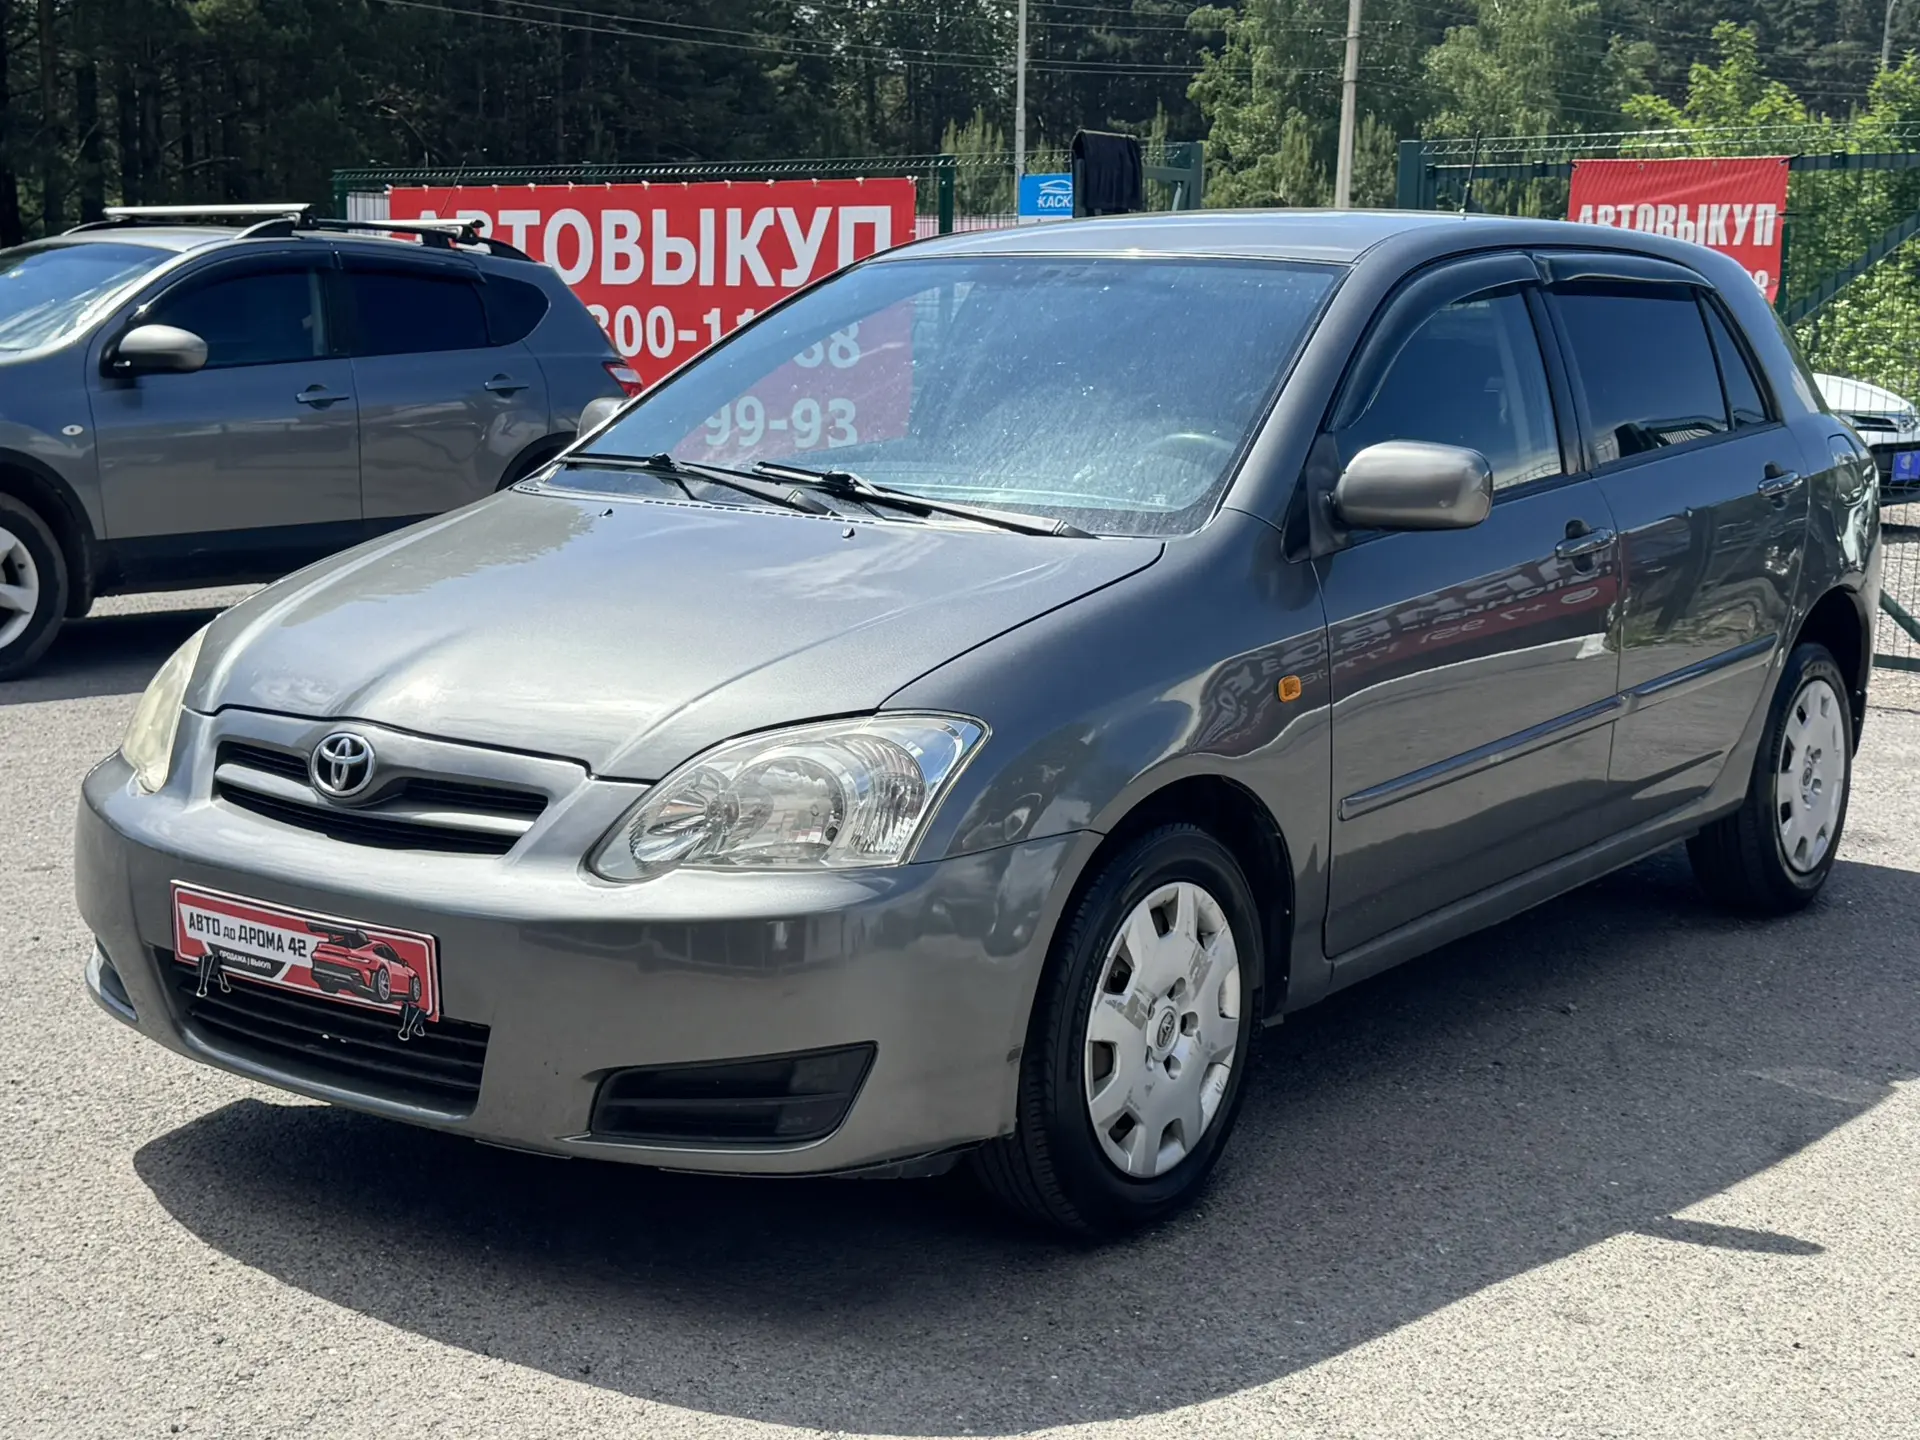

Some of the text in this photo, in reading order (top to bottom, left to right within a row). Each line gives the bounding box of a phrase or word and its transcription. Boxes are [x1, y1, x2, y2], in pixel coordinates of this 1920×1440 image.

[416, 205, 893, 287] ТОВЫКУП
[189, 911, 220, 937] АВТО
[238, 924, 285, 953] ДРОМА
[288, 937, 308, 958] 42
[219, 949, 247, 964] ПРОДАЖА
